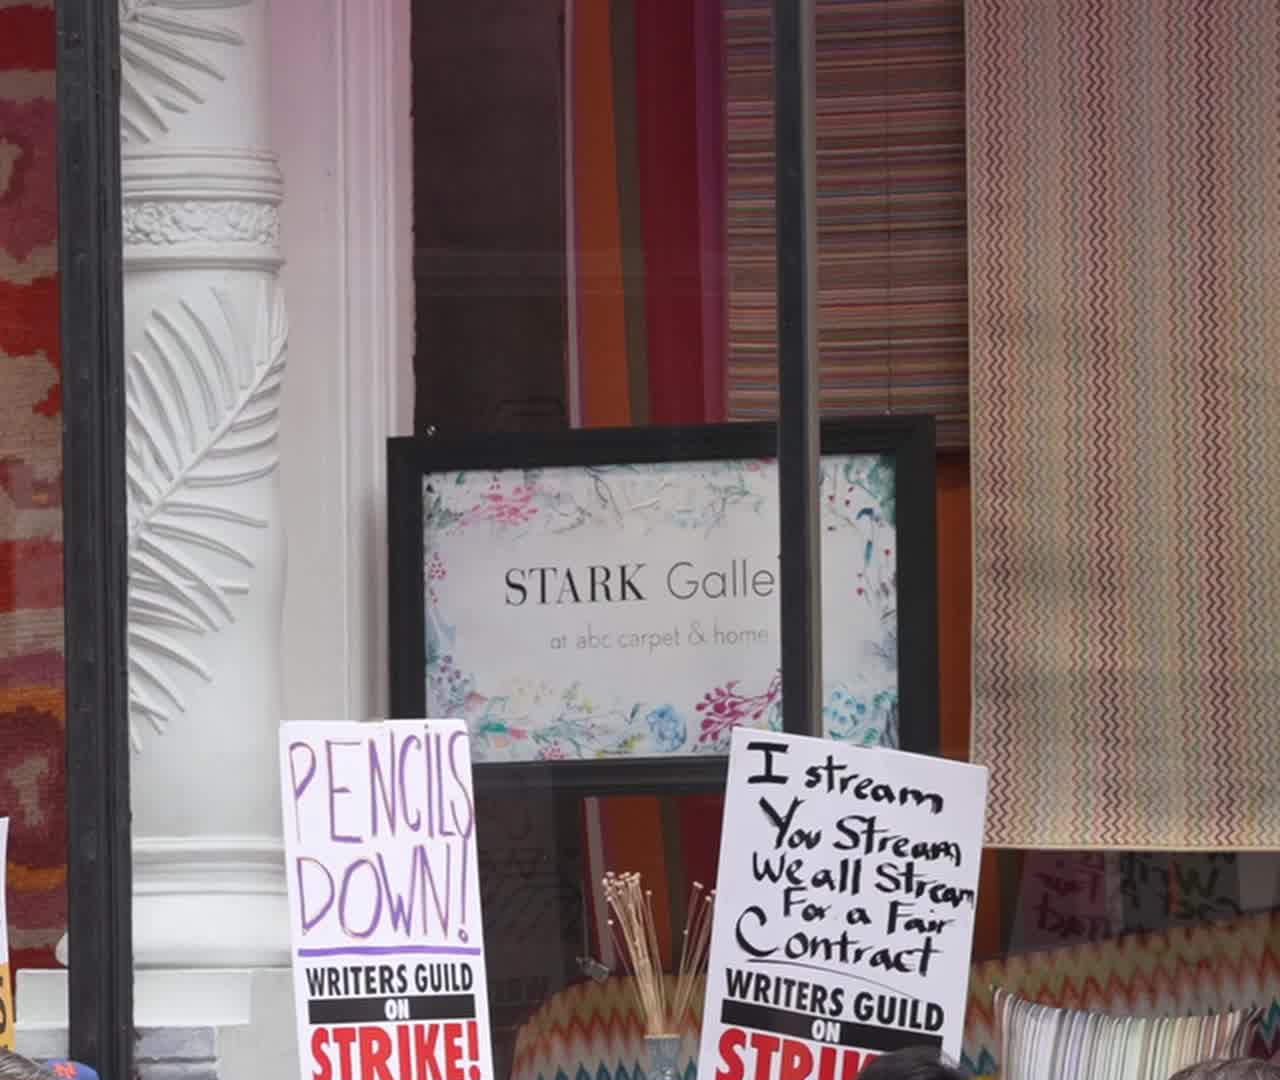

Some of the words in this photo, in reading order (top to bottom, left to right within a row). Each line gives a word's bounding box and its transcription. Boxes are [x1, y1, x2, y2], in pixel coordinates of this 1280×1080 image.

[505, 563, 648, 606] STARK
[667, 558, 776, 600] Galle
[550, 635, 568, 650] at
[576, 623, 612, 650] abc
[619, 628, 680, 655] carpet
[688, 623, 706, 646] &
[713, 622, 768, 647] home
[746, 741, 790, 785] I
[805, 755, 945, 815] stream
[759, 796, 823, 850] You
[833, 814, 962, 867] Stream
[296, 839, 469, 944] DOWN!
[752, 851, 804, 885] We
[811, 858, 863, 896] all
[783, 886, 832, 922] For
[846, 907, 871, 925] a
[887, 900, 956, 935] Fair
[735, 905, 944, 977] Contract
[306, 963, 408, 997] WRITERS
[414, 961, 474, 993] GUILD
[726, 968, 845, 1017] WRITERS
[853, 991, 945, 1032] GUILD
[384, 998, 410, 1020] ON
[811, 1019, 841, 1044] ON
